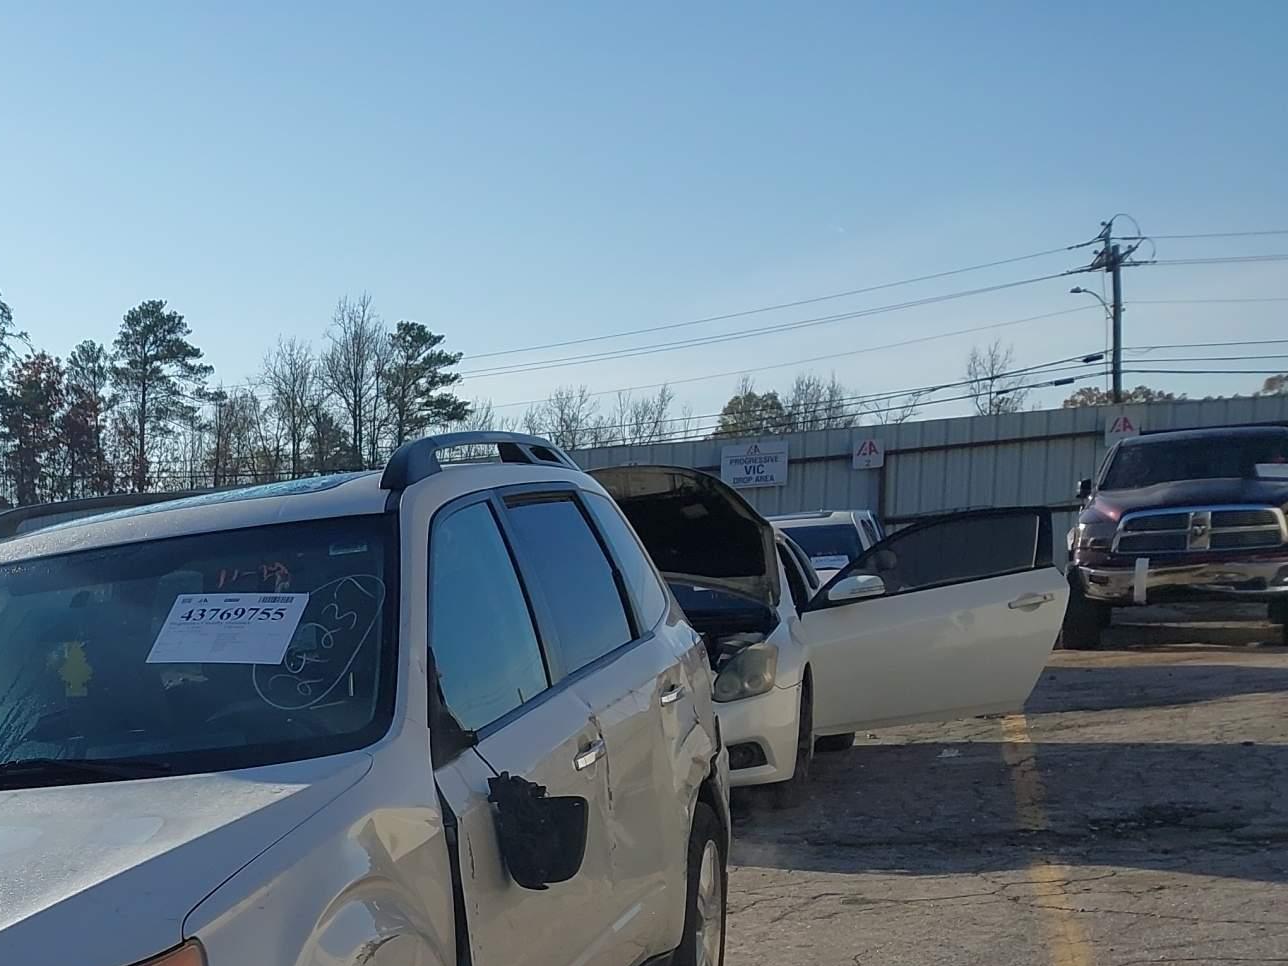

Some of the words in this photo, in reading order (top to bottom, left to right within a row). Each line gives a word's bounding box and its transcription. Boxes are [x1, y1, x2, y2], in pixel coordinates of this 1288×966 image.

[729, 455, 779, 465] PROGRESSIVE
[744, 464, 765, 475] VIC
[733, 476, 753, 484] DROP
[754, 475, 775, 483] AREA
[180, 607, 288, 622] 43769755
